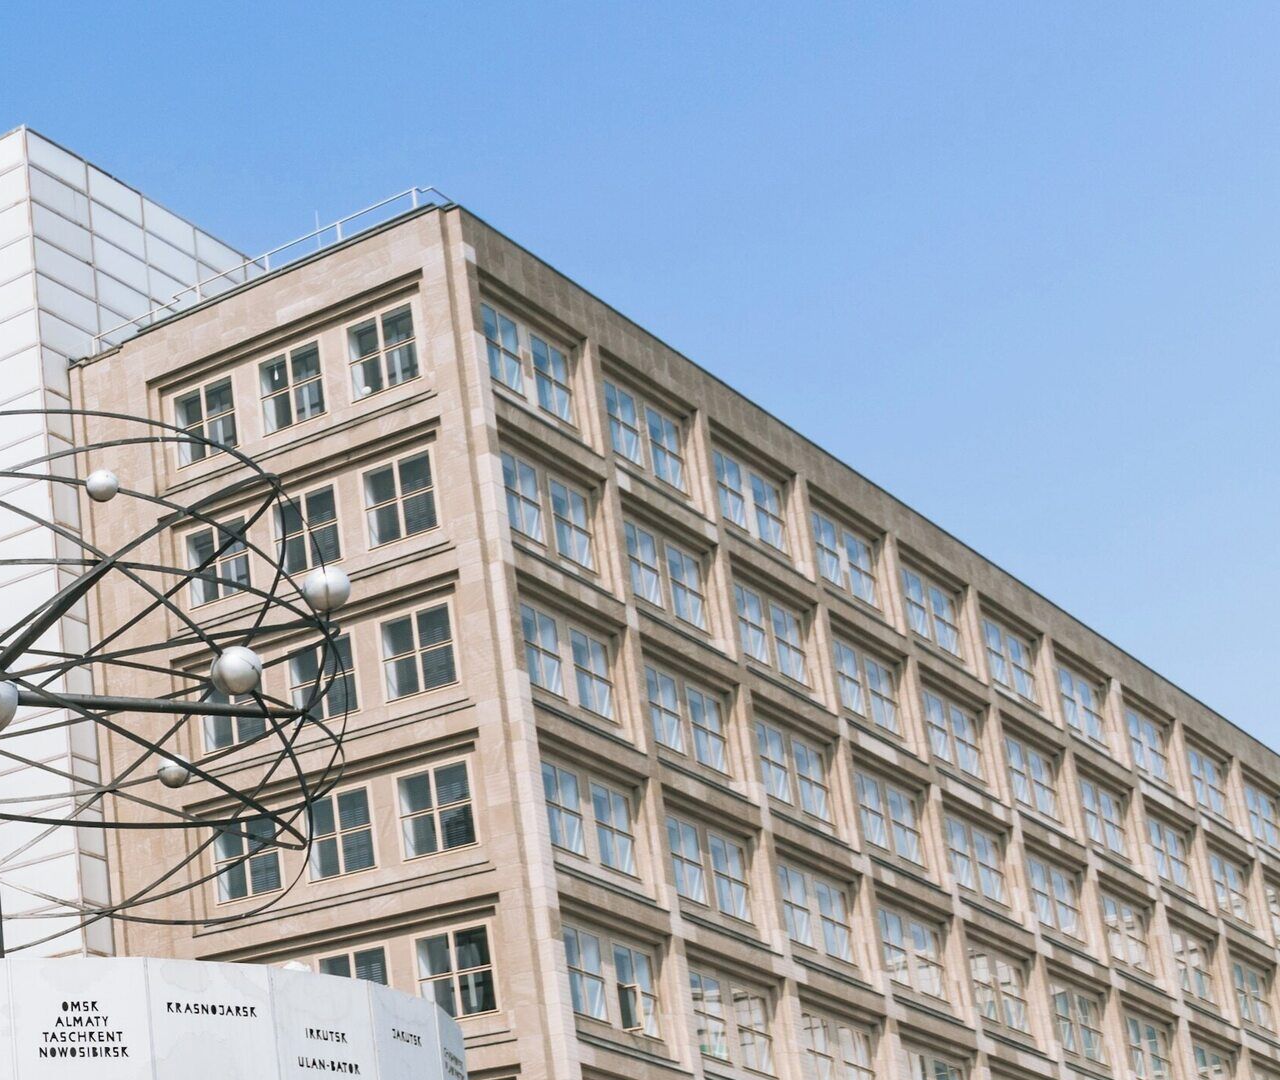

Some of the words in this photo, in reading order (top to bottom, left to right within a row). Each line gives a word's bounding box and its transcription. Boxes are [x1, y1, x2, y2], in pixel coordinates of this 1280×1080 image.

[62, 1001, 99, 1012] OMSK
[166, 1002, 257, 1018] KRASNOJARSK
[55, 1016, 108, 1028] ALMATY
[42, 1032, 122, 1042] TASCHKENT
[305, 1028, 348, 1044] IRKUTSK
[392, 1028, 422, 1047] JAKUTSK
[39, 1046, 130, 1058] NOWOSIBIRSK
[298, 1056, 360, 1075] ULAN-BATOR
